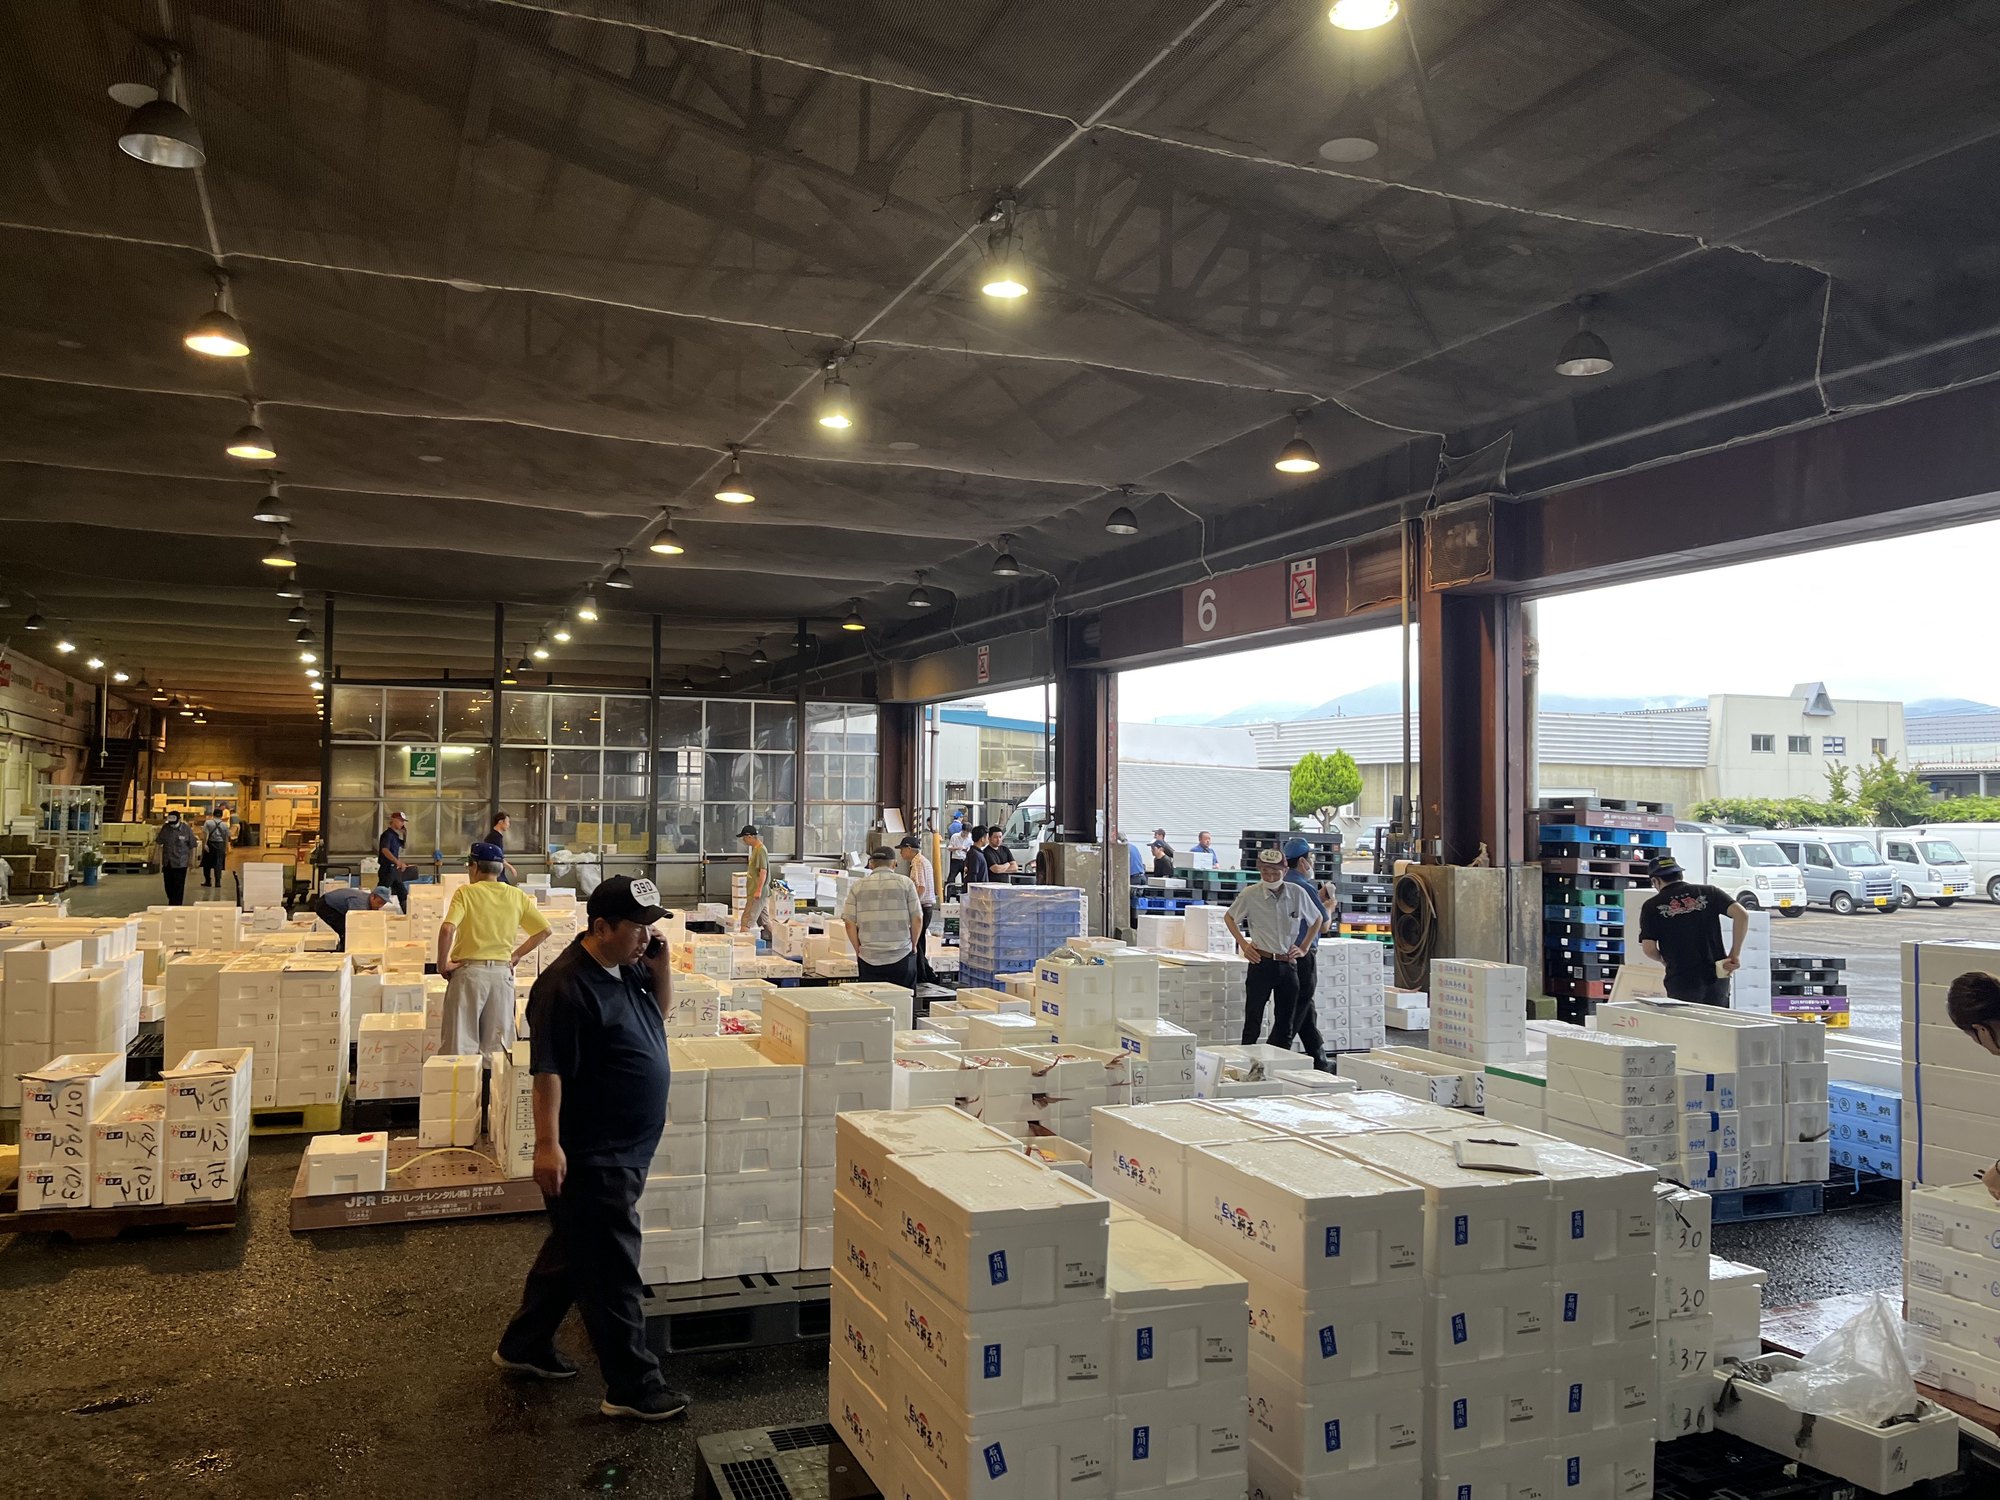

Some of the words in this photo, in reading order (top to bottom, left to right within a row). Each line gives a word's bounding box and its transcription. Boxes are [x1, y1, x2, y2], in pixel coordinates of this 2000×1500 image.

[1198, 588, 1217, 632] 6
[633, 881, 653, 894] 390
[1181, 1044, 1193, 1060] 18
[1181, 1068, 1192, 1080] 18
[345, 1195, 377, 1208] JPR
[381, 1187, 470, 1206] 日本パレットレンタル(株)
[993, 1253, 1004, 1271] 石川
[1680, 1287, 1705, 1308] 3.0
[1141, 1329, 1149, 1345] 石川
[988, 1347, 998, 1363] 石川
[1681, 1348, 1707, 1371] 3.7
[1137, 1429, 1146, 1446] 石川
[988, 1446, 1001, 1465] 石川
